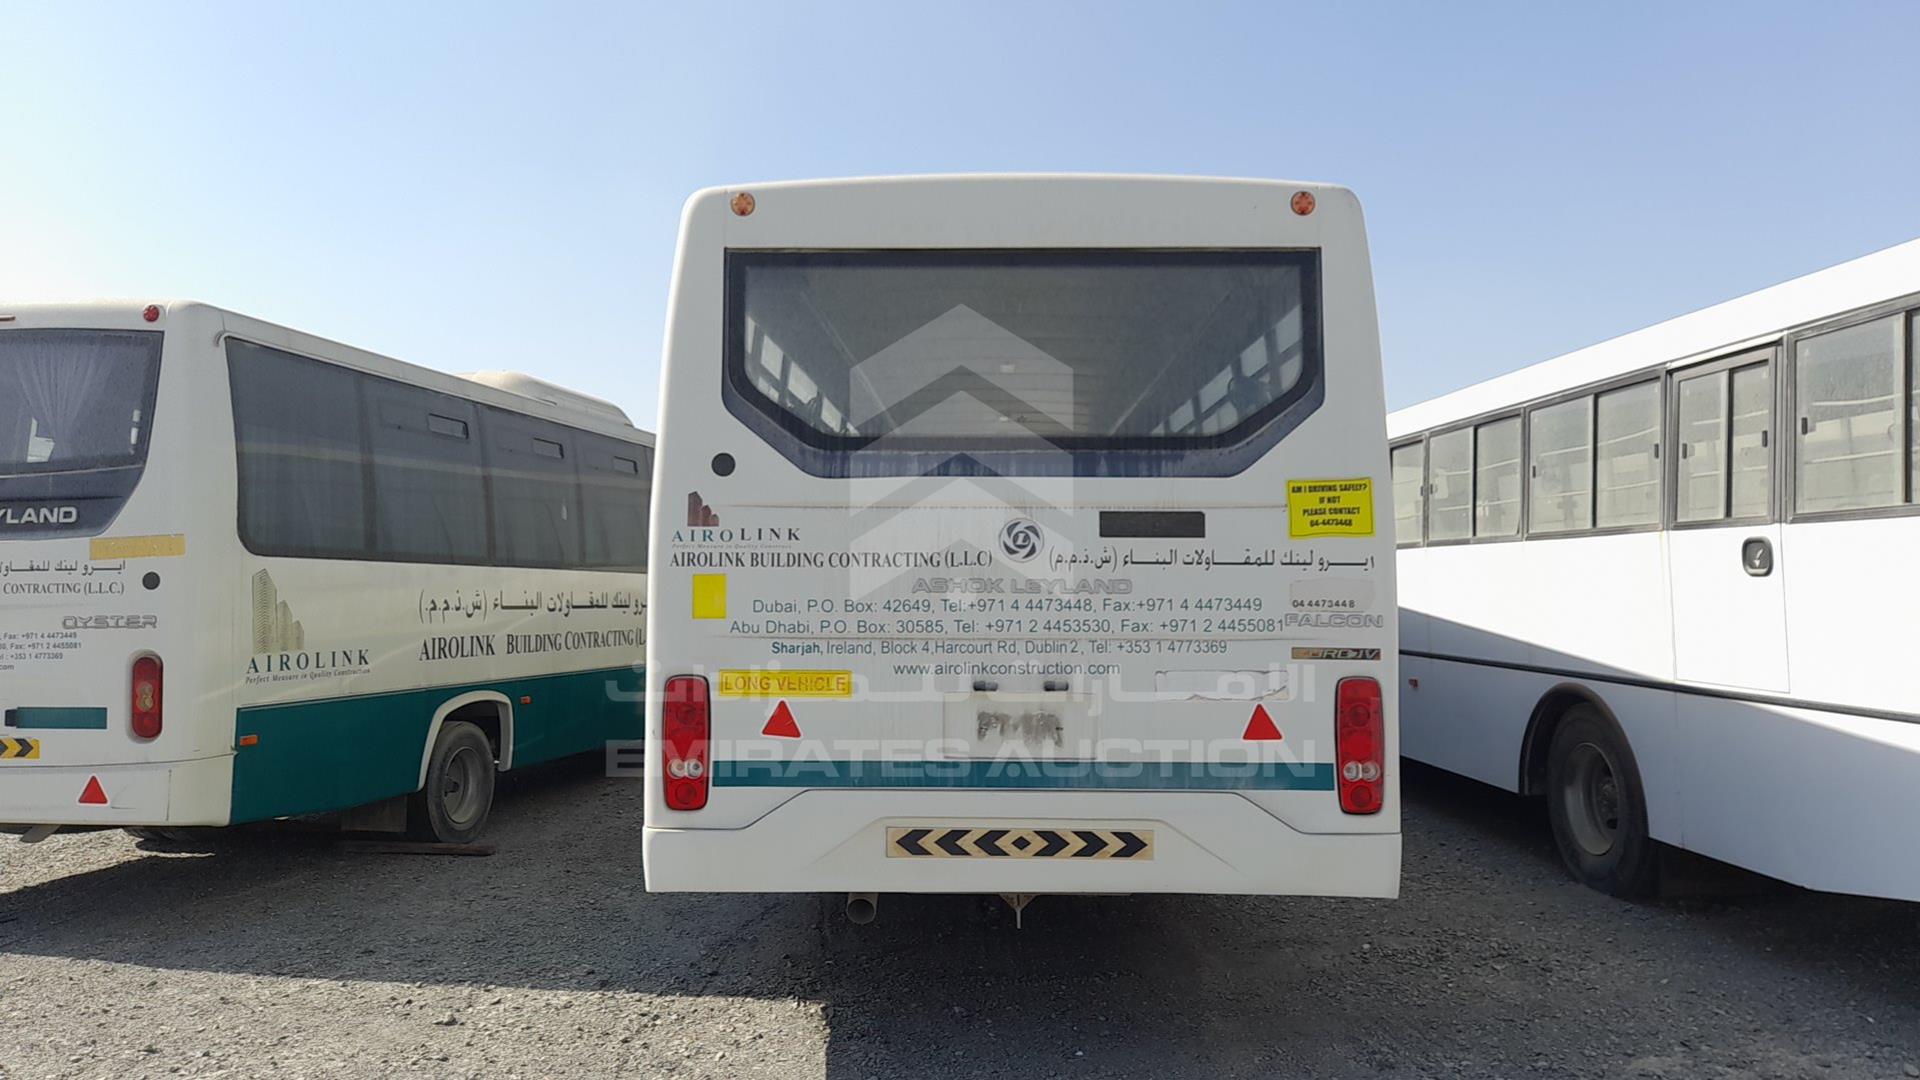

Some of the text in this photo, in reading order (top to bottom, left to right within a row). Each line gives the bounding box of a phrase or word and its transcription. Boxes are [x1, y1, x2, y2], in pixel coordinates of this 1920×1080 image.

[1327, 496, 1341, 504] NOT
[1302, 506, 1361, 516] PLEASE CONTACT
[671, 527, 801, 543] AIROLINK
[670, 551, 745, 568] AIROLINK
[750, 551, 824, 568] BUILDING
[828, 551, 941, 568] CONTRACTING
[1122, 548, 1177, 571] البناء
[1182, 549, 1275, 571] للمقاولات
[3, 582, 81, 595] CONTRACTING
[911, 577, 1133, 595] ASHOK LEYLAND
[492, 590, 542, 616] البناء
[546, 591, 608, 618] للمقاولات
[752, 598, 802, 614] Dubai,
[807, 598, 837, 613] P.O.
[844, 598, 878, 613] Box:
[882, 598, 935, 614] 42649,
[1010, 598, 1020, 612] 4
[1024, 598, 1097, 614] 4473448,
[1179, 598, 1189, 612] 4
[1194, 597, 1263, 612] 4473449
[62, 615, 158, 629] OYSTER
[729, 618, 1284, 635] Abu Dhabi, P.O. Box: 30585, Tel: +971 2 4453530, Fax: +971 2 4455081
[1285, 612, 1384, 628] FALCON
[419, 634, 496, 661] AIROLINK
[506, 632, 562, 655] BUILDING
[564, 627, 634, 650] CONTRACTING
[771, 641, 824, 656] Sharjah,
[826, 640, 876, 656] Ireland,
[881, 640, 918, 654] Block
[997, 640, 1021, 656] Rd,
[1089, 640, 1111, 654] Tel:
[1116, 640, 1151, 654] +353
[1156, 641, 1162, 653] 1
[1168, 640, 1227, 654] 4773369
[246, 648, 370, 675] AIROLINK
[893, 660, 1121, 676] www.airolinkconstruction.com
[724, 674, 847, 692] LONG VEHICLE
